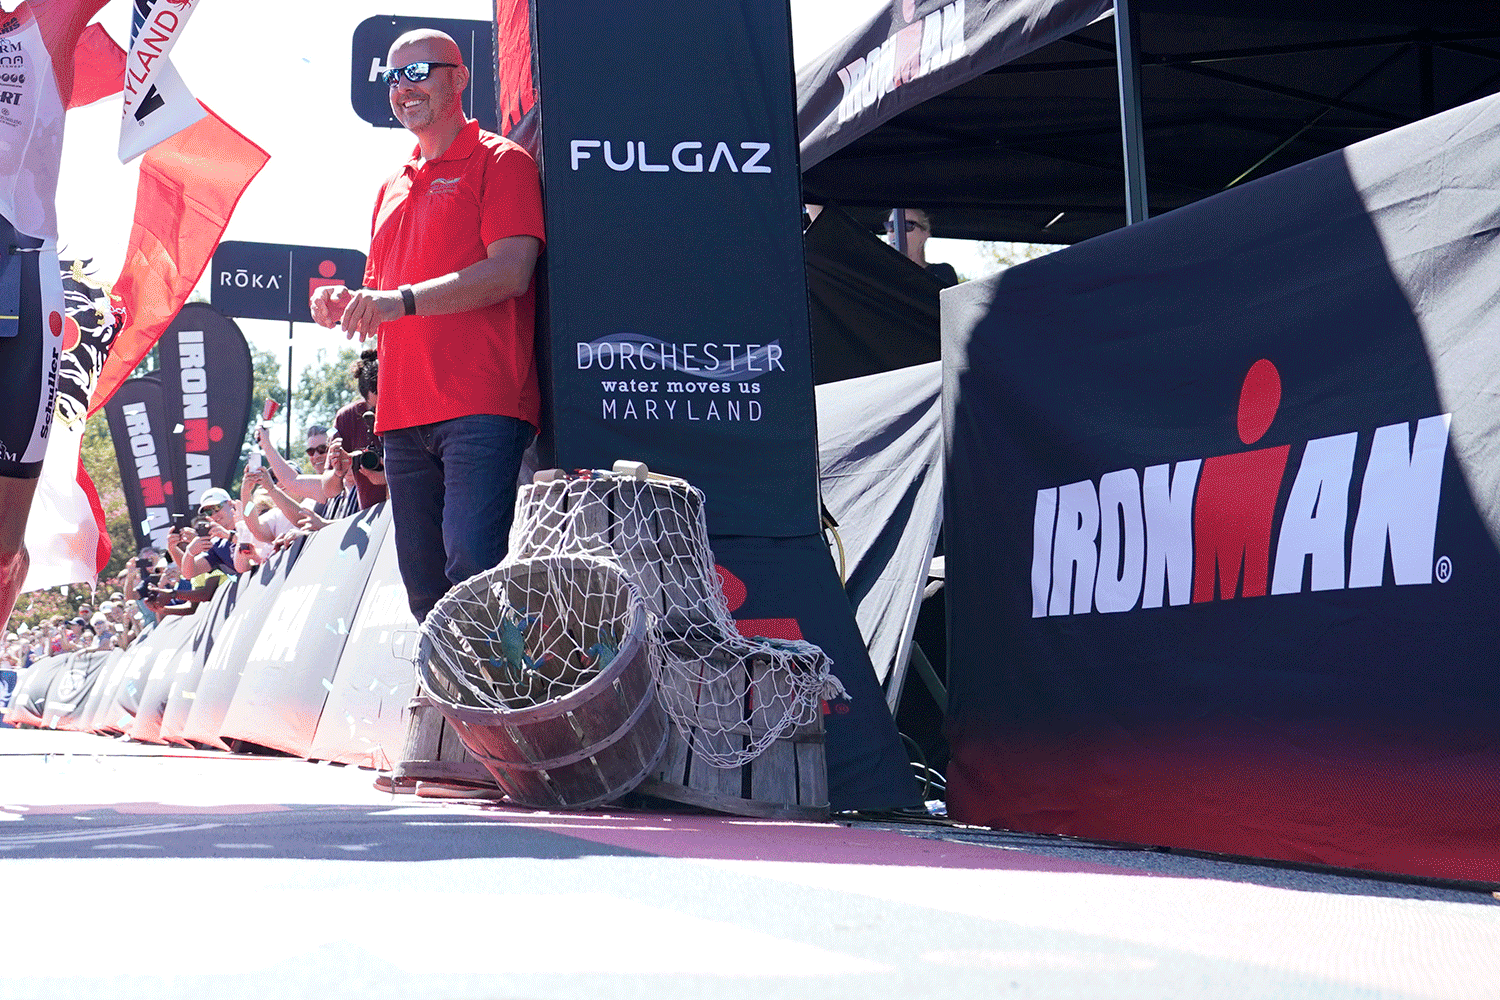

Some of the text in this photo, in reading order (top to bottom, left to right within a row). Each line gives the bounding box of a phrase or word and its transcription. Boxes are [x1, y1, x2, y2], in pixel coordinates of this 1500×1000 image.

[123, 10, 179, 107] YLAND
[570, 140, 772, 173] FULGAZ
[577, 341, 785, 372] DORCHESTER
[601, 379, 761, 394] water moves us
[602, 398, 762, 422] MARYLAND
[1031, 413, 1451, 618] IRONMAN
